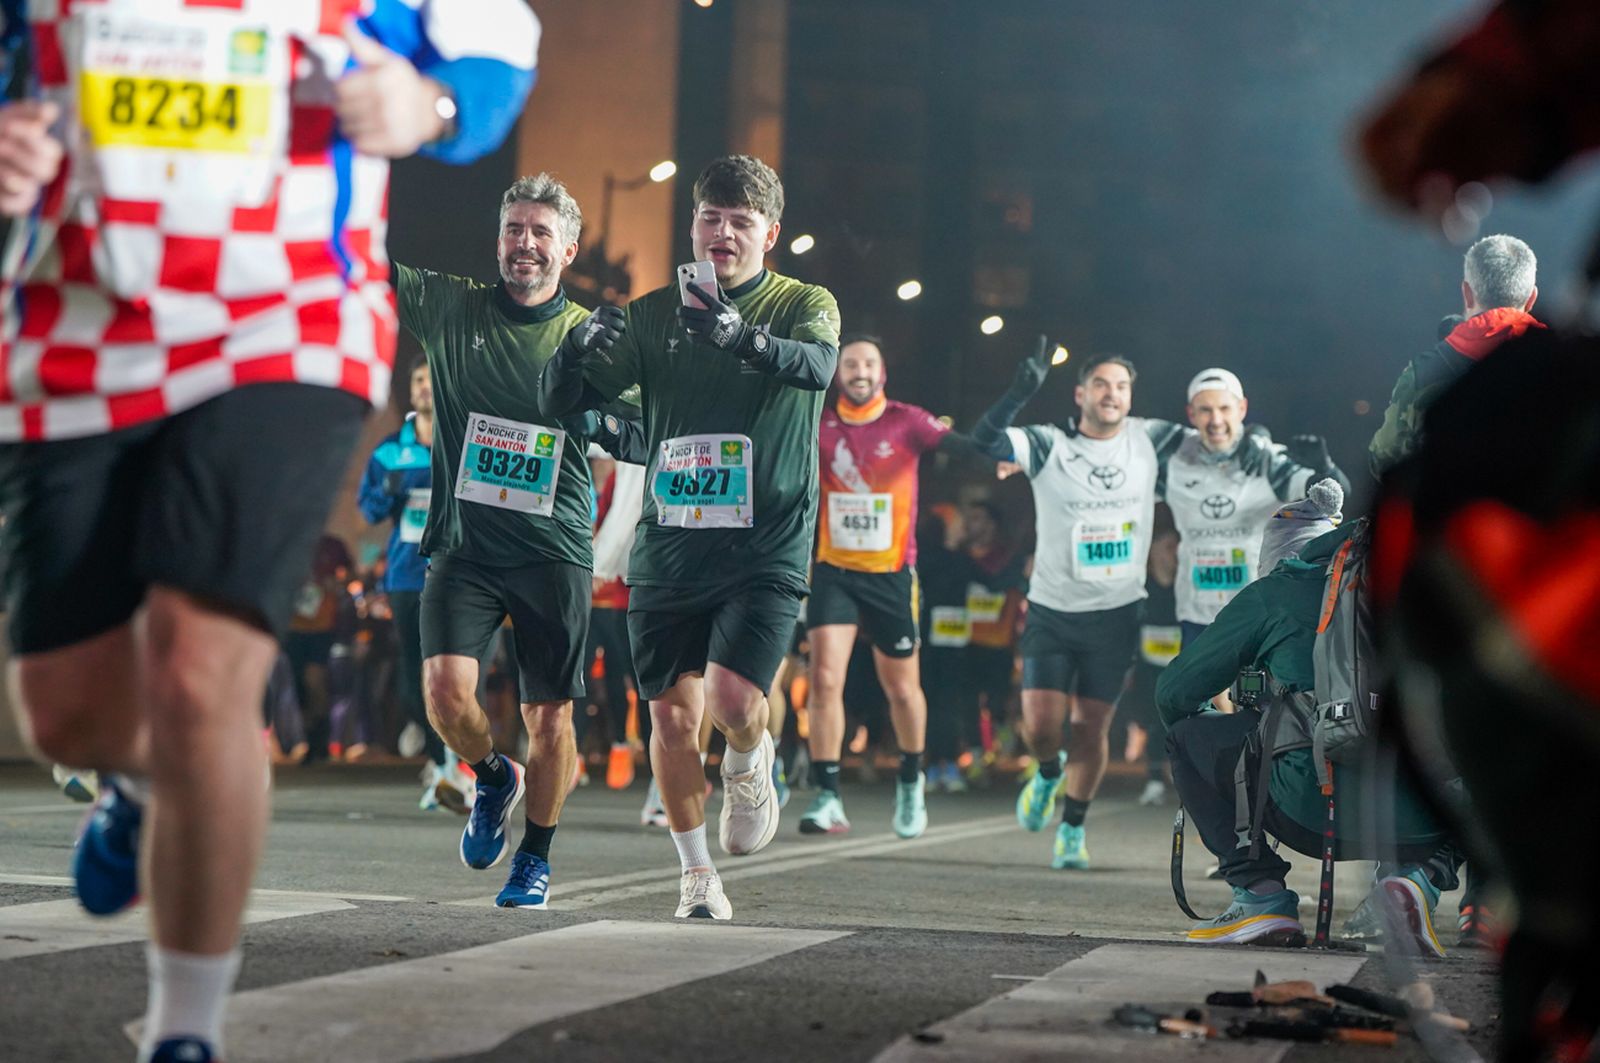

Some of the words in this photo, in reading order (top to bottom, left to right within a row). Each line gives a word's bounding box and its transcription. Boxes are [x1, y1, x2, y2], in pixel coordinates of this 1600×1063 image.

[110, 77, 238, 133] 8234
[475, 434, 493, 446] SAN
[494, 438, 527, 453] ANTÓN
[487, 426, 516, 440] NOCHE
[516, 432, 528, 442] DE
[700, 444, 711, 454] DE
[477, 447, 541, 483] 9329
[669, 468, 731, 496] 9327
[841, 514, 878, 530] 4631
[1085, 540, 1128, 561] 14011
